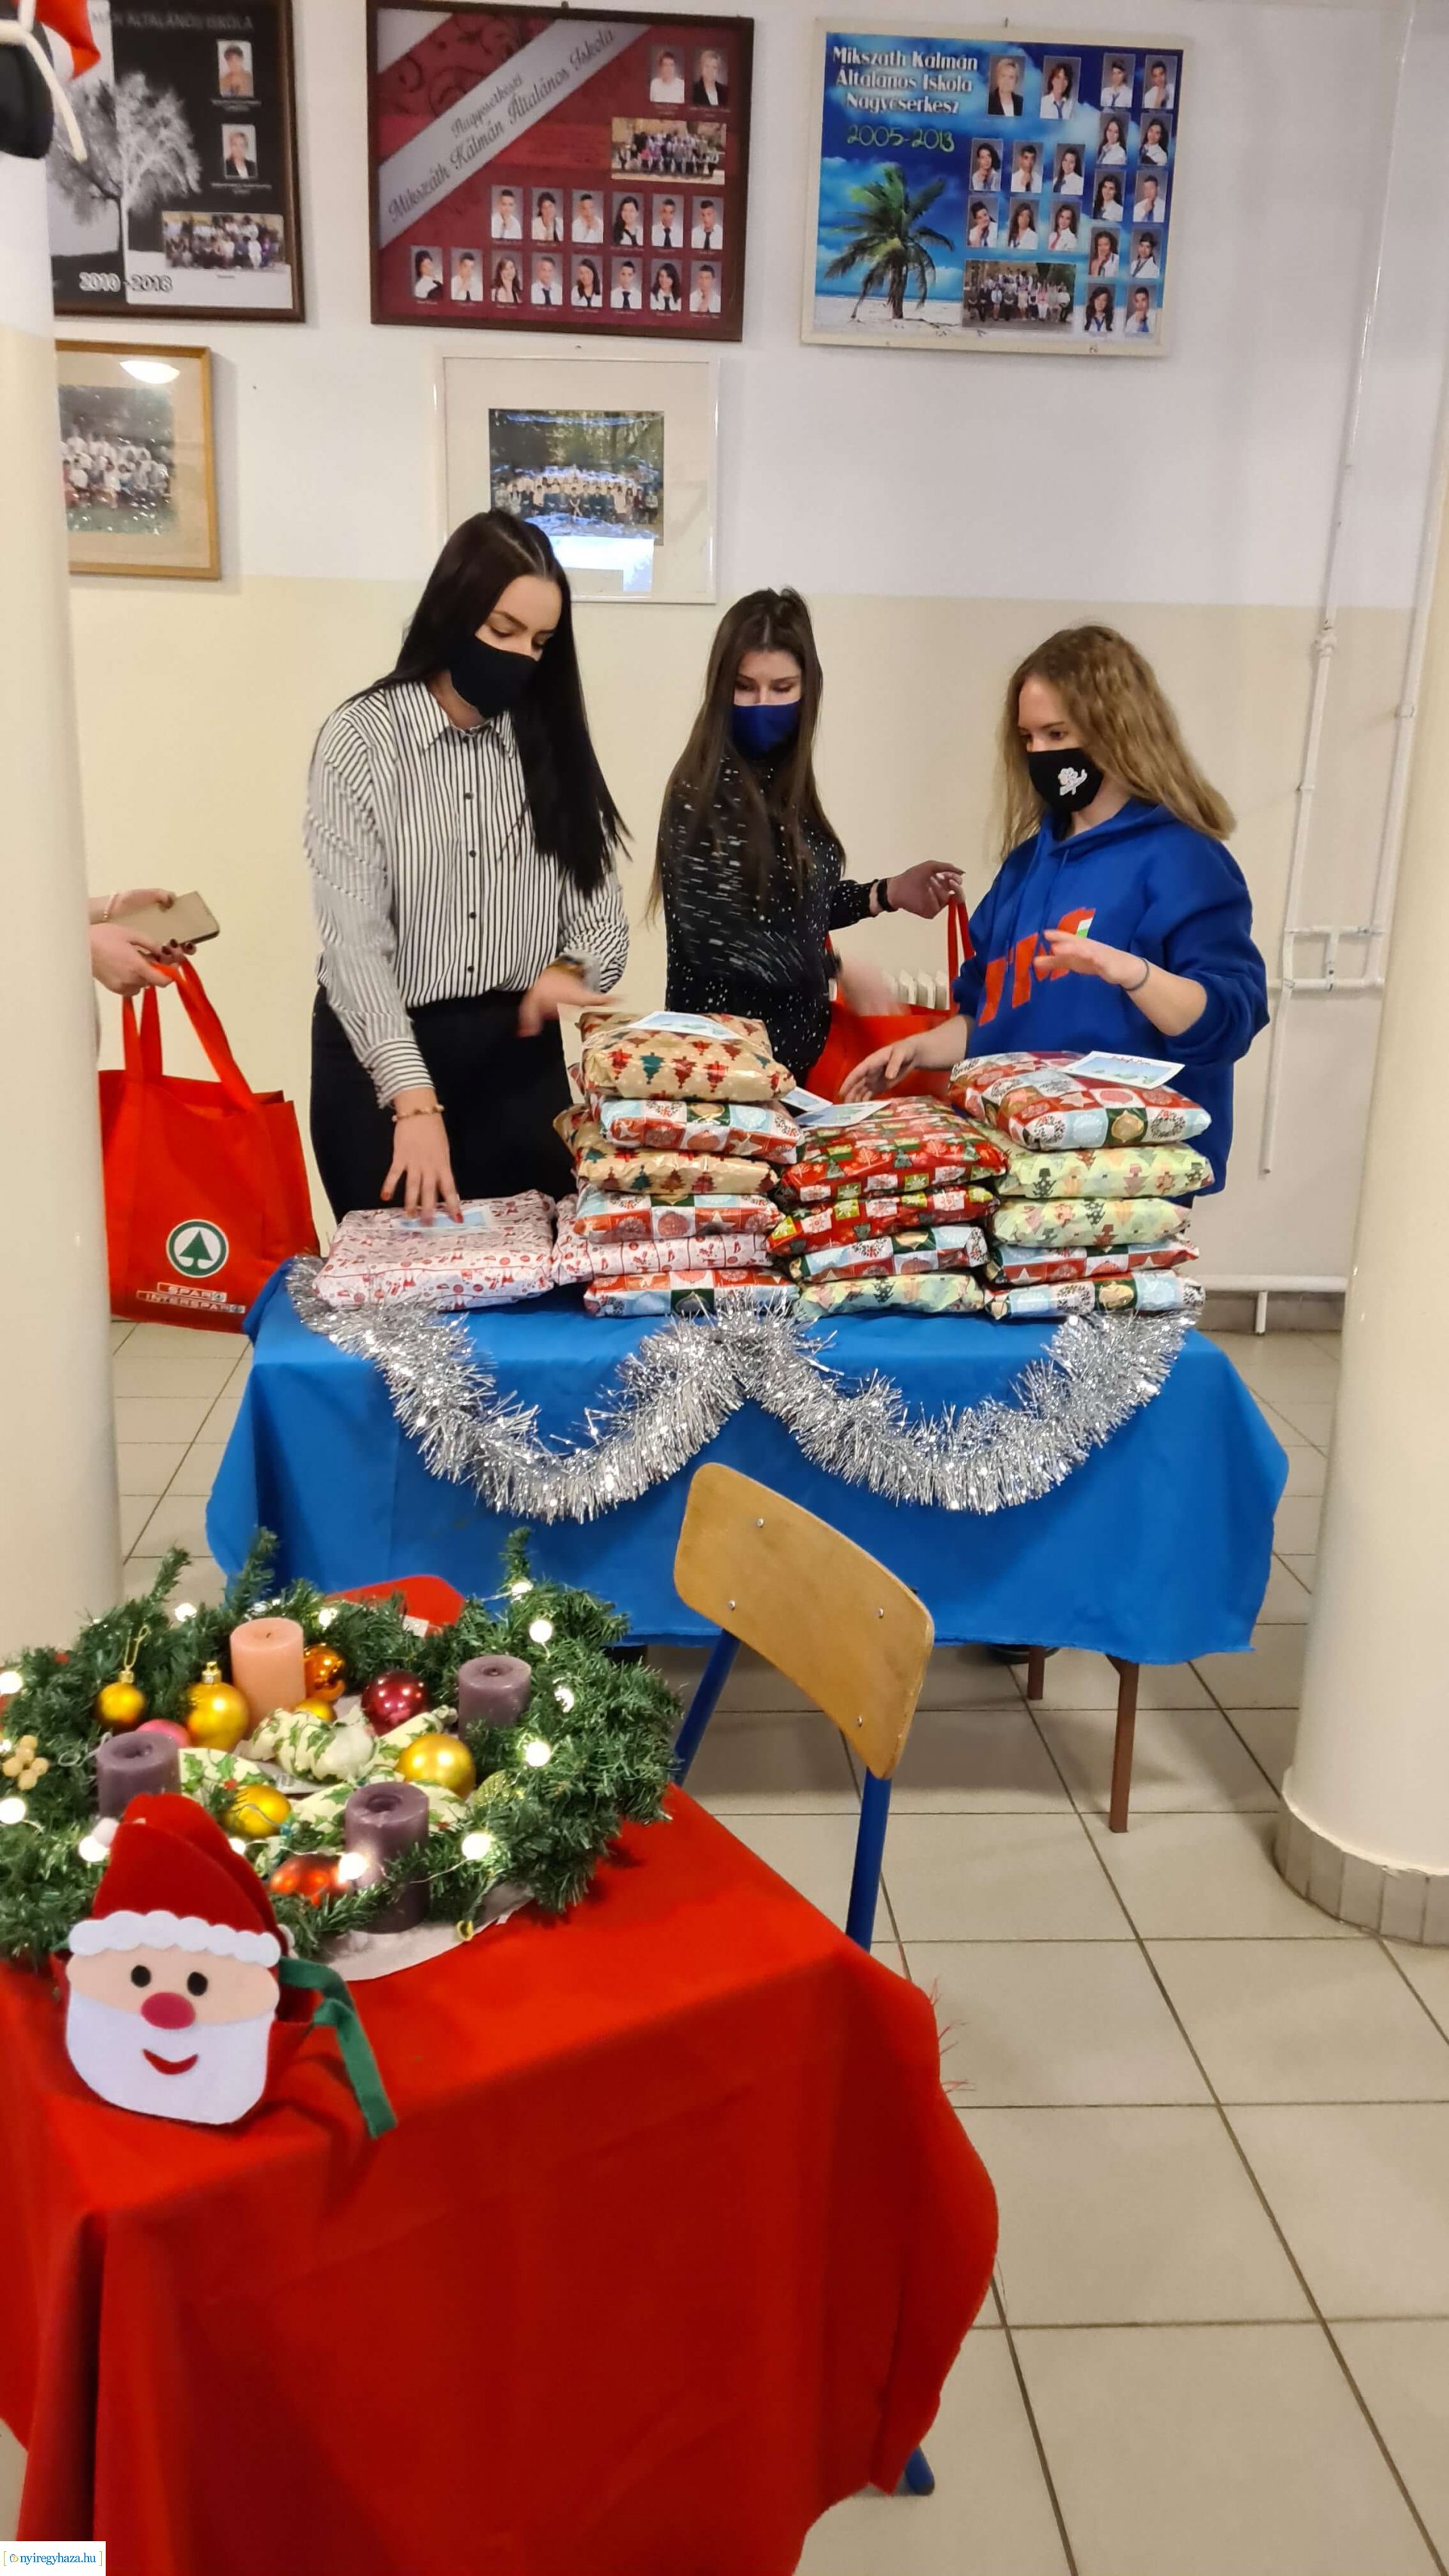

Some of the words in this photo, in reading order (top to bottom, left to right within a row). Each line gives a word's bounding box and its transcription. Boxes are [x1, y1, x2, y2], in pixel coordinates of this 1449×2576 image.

[912, 51, 978, 71] Kálmán
[922, 74, 973, 91] Iskola
[847, 91, 960, 114] Nagycserkesz
[389, 164, 451, 222] Mikszáth
[450, 120, 505, 169] Kálmán
[570, 28, 616, 70] Iskola
[847, 124, 955, 153] 2005-2013
[146, 1291, 230, 1312] INTERSPAR
[168, 1285, 213, 1300] SPAR
